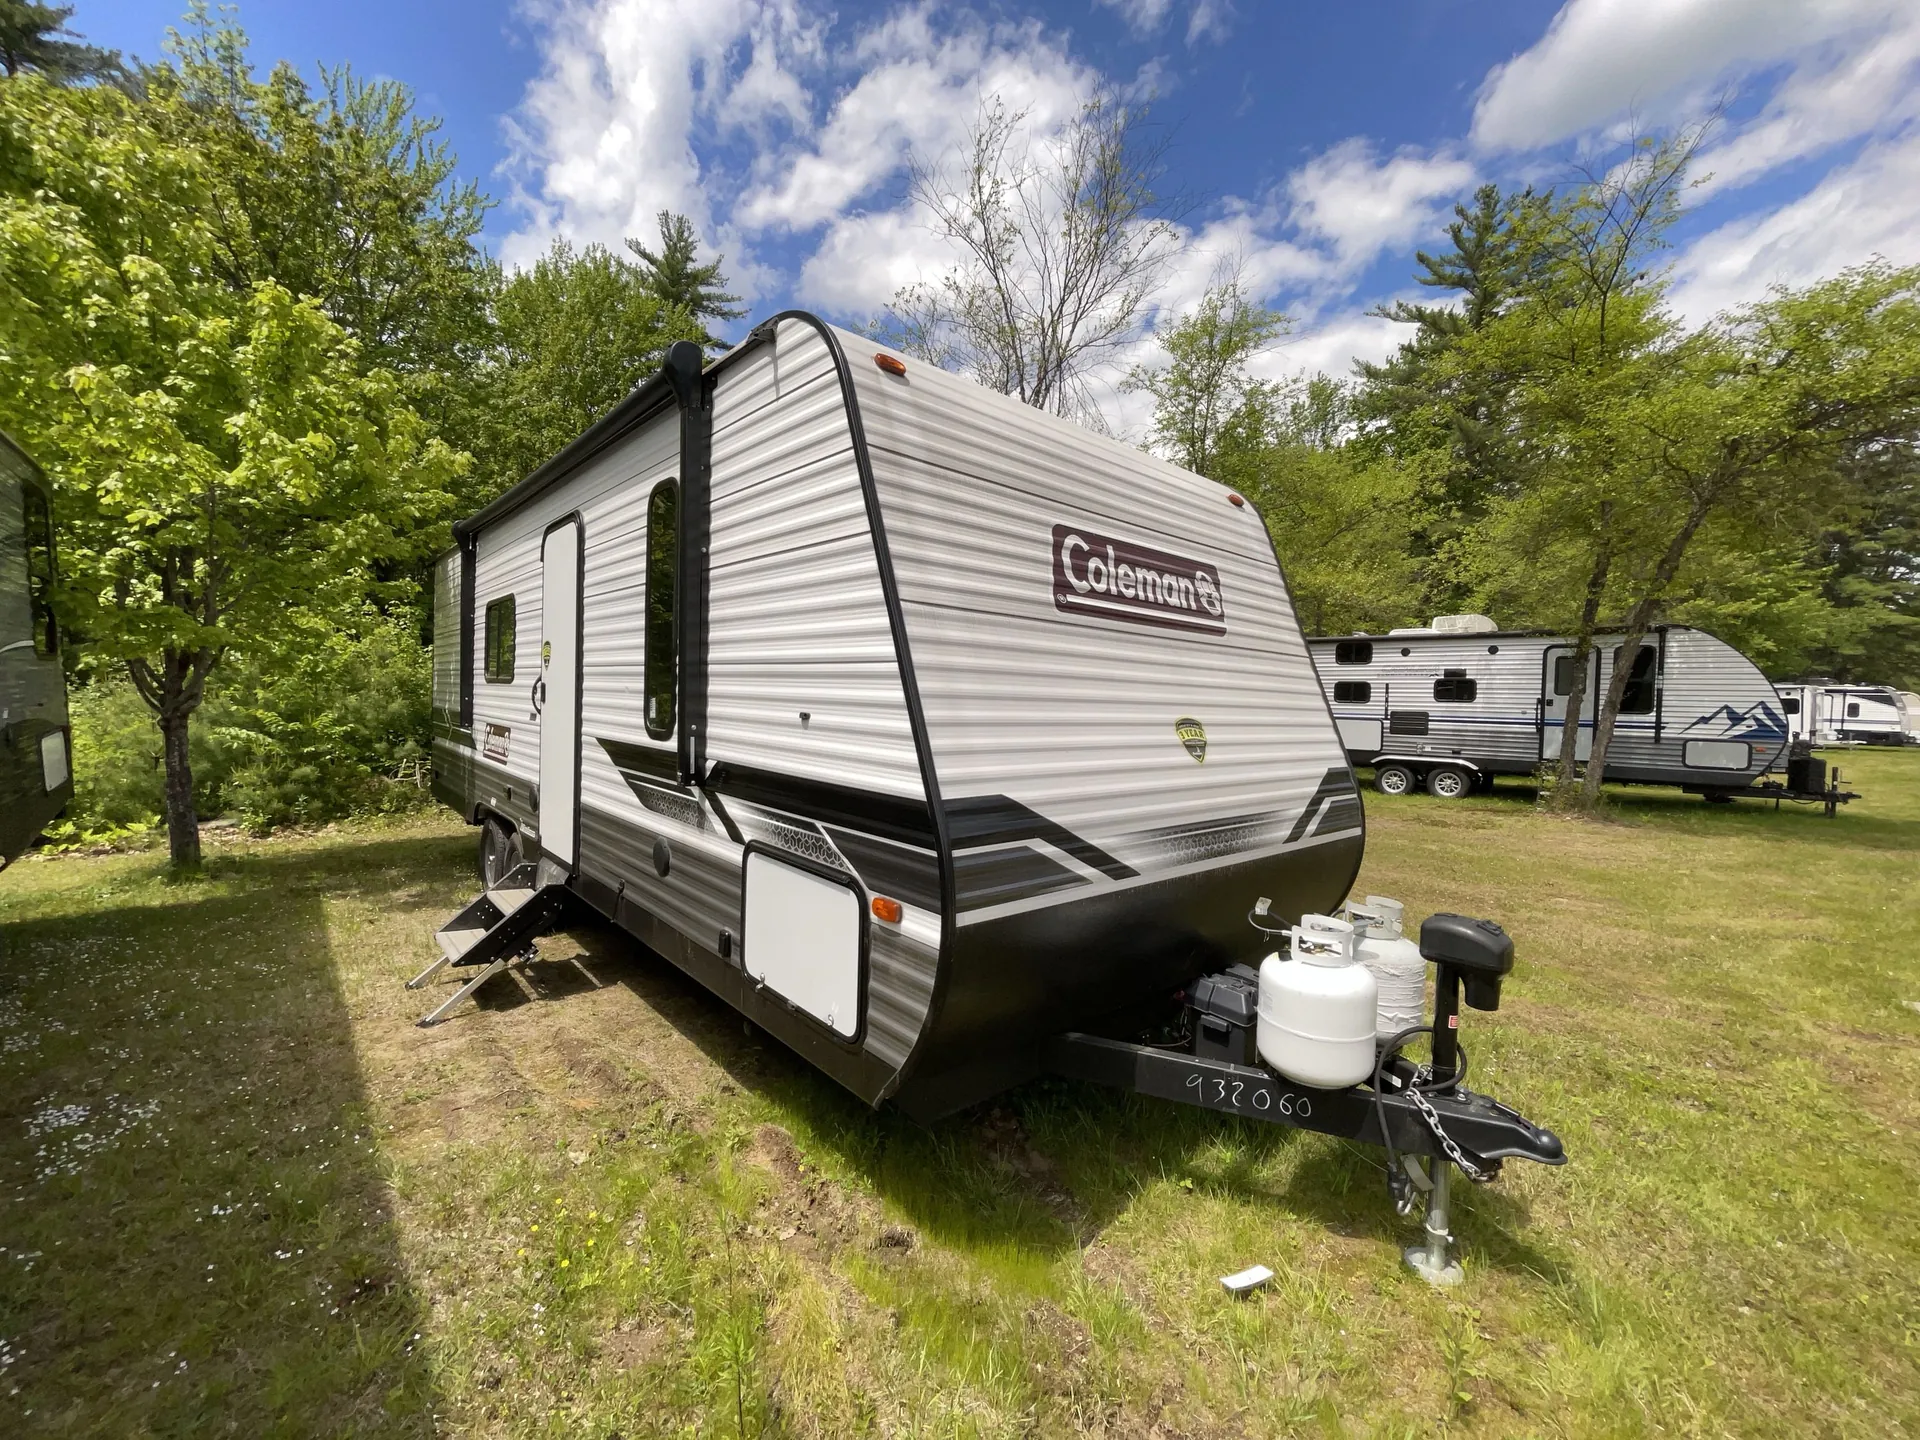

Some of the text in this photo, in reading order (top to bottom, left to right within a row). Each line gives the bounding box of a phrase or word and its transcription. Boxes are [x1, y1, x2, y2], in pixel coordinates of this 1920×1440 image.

[1061, 533, 1197, 610] Coleman
[1184, 728, 1205, 739] YEAR
[1186, 1073, 1312, 1117] 932060
